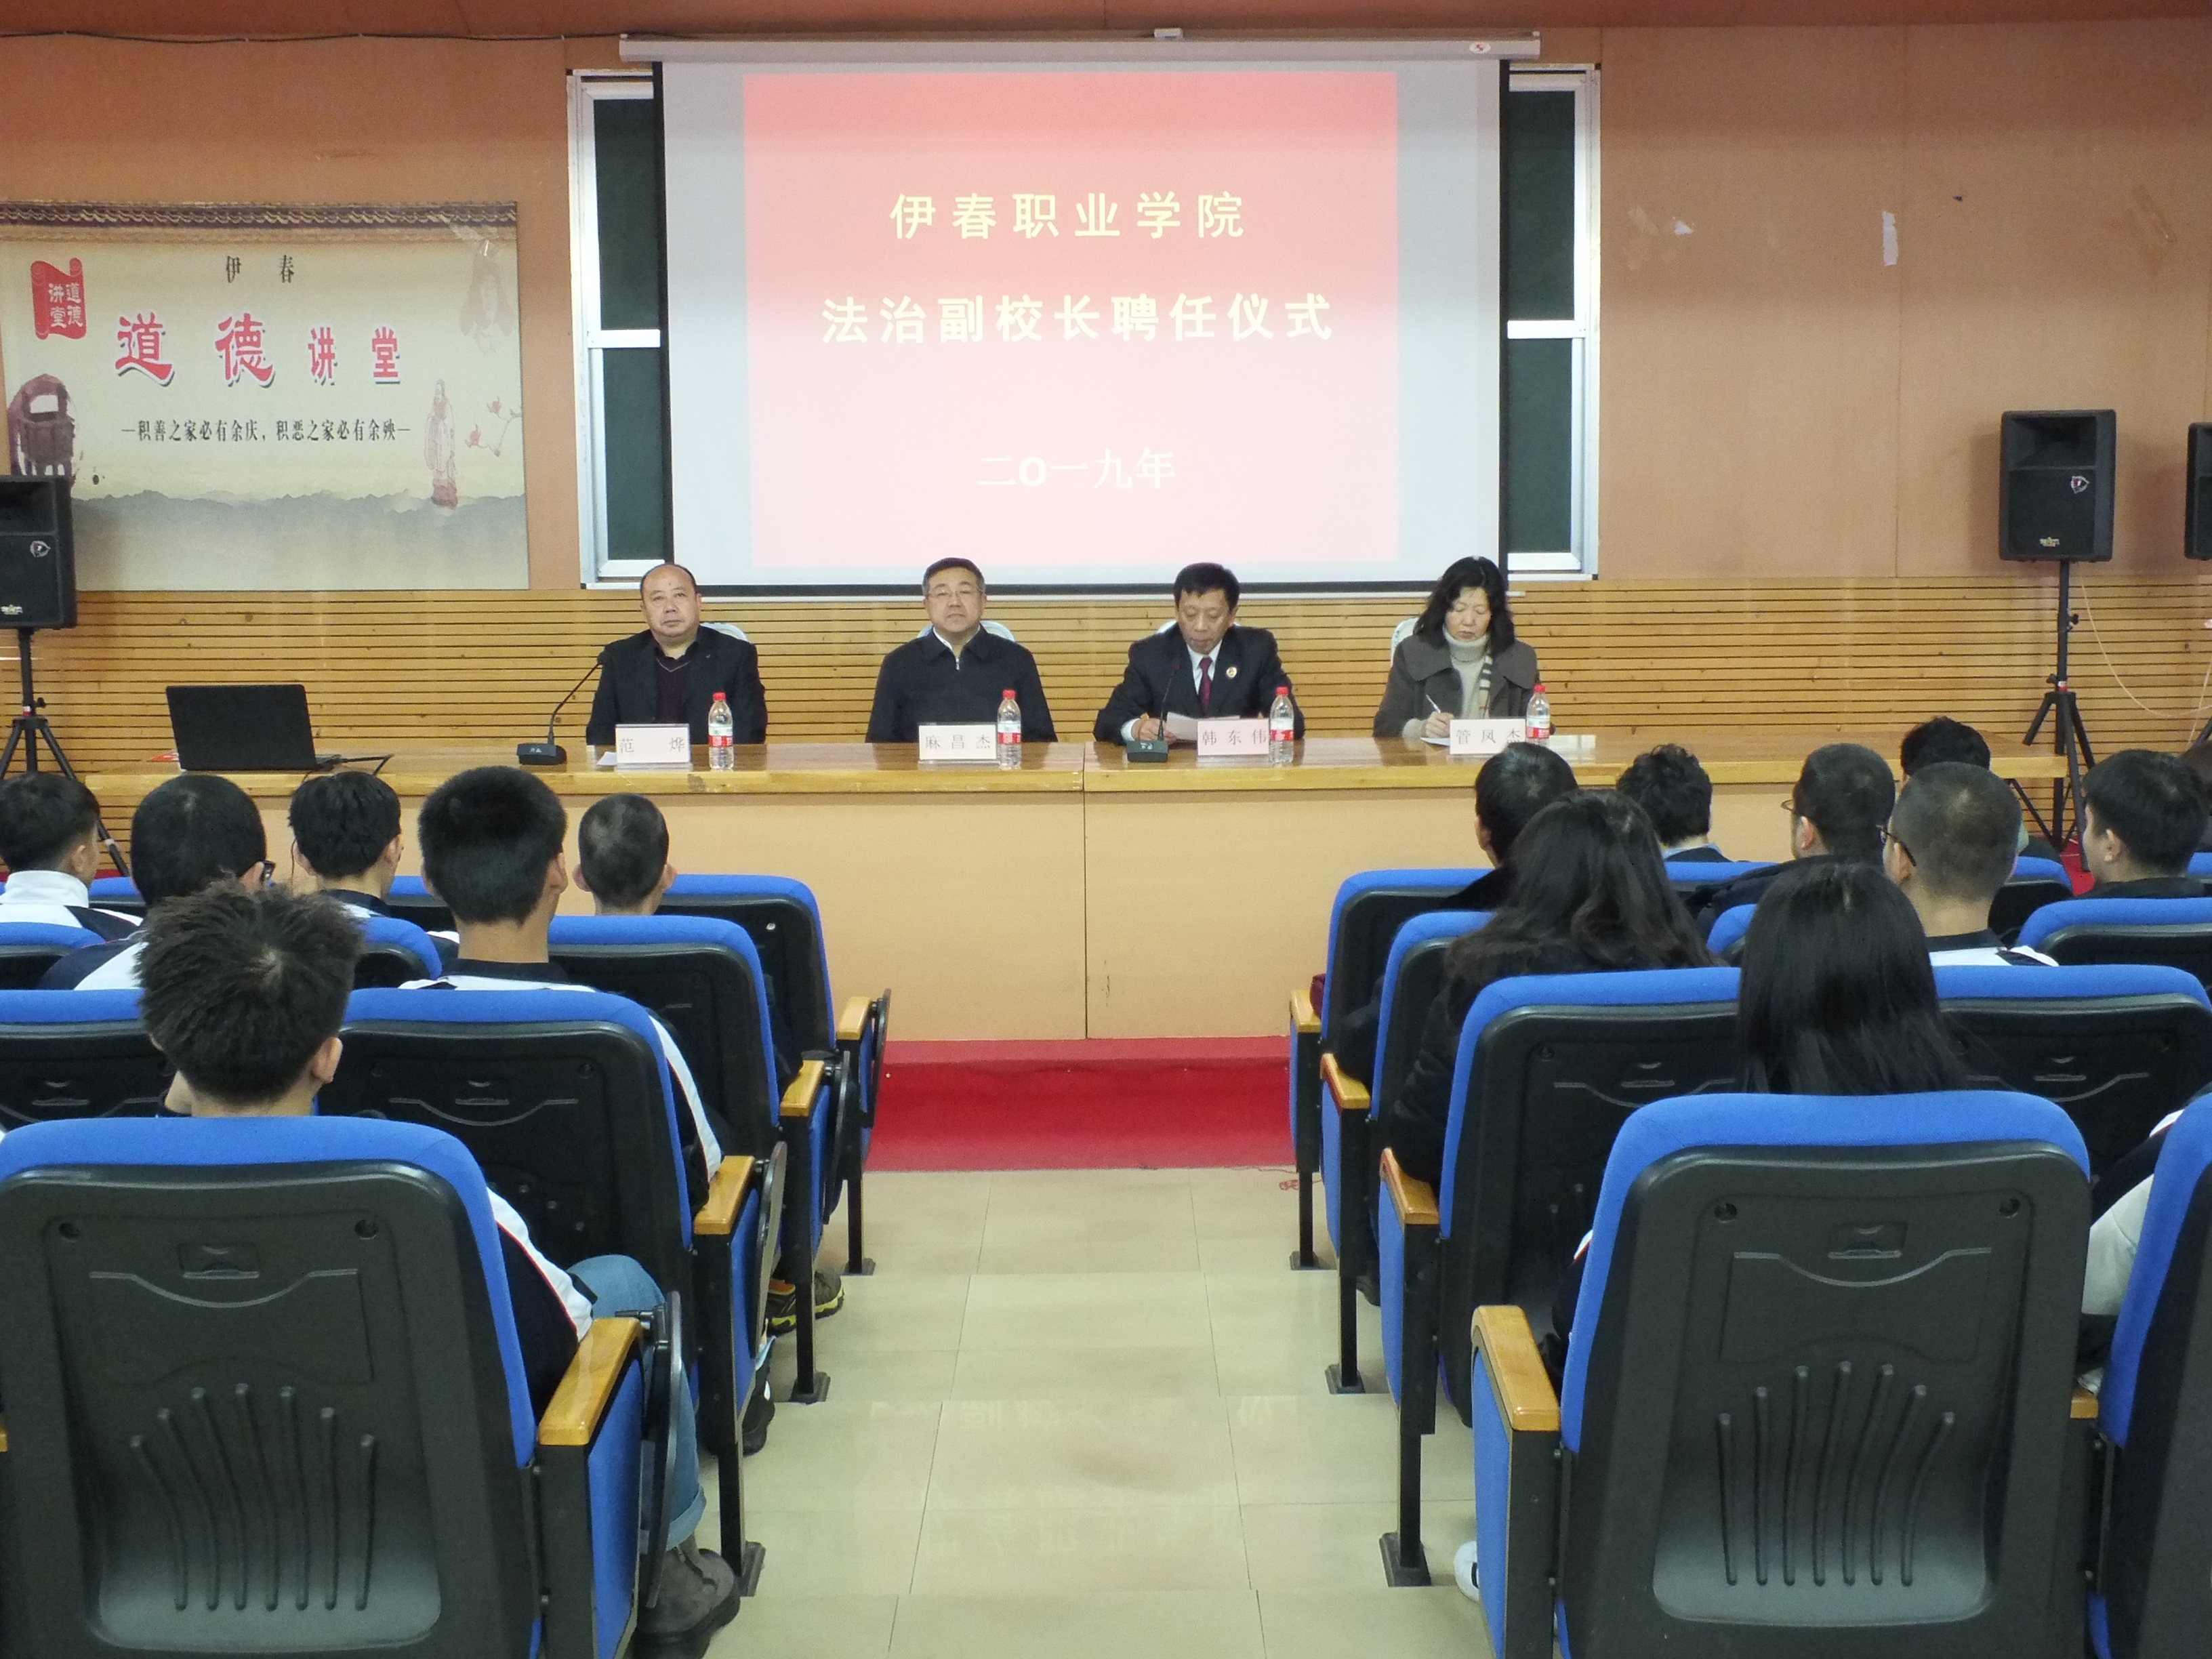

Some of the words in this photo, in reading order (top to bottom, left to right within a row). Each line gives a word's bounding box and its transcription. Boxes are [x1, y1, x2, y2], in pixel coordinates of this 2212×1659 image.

[889, 191, 1244, 240] 伊春职业学院
[226, 254, 295, 283] 伊春
[821, 292, 1332, 344] 法治副校长聘任仪式
[115, 312, 401, 387] 道德讲堂
[619, 737, 685, 754] 范烨
[925, 734, 991, 750] 麻昌杰
[1202, 729, 1267, 745] 韩东伟
[1456, 728, 1521, 745] 管凤杰
